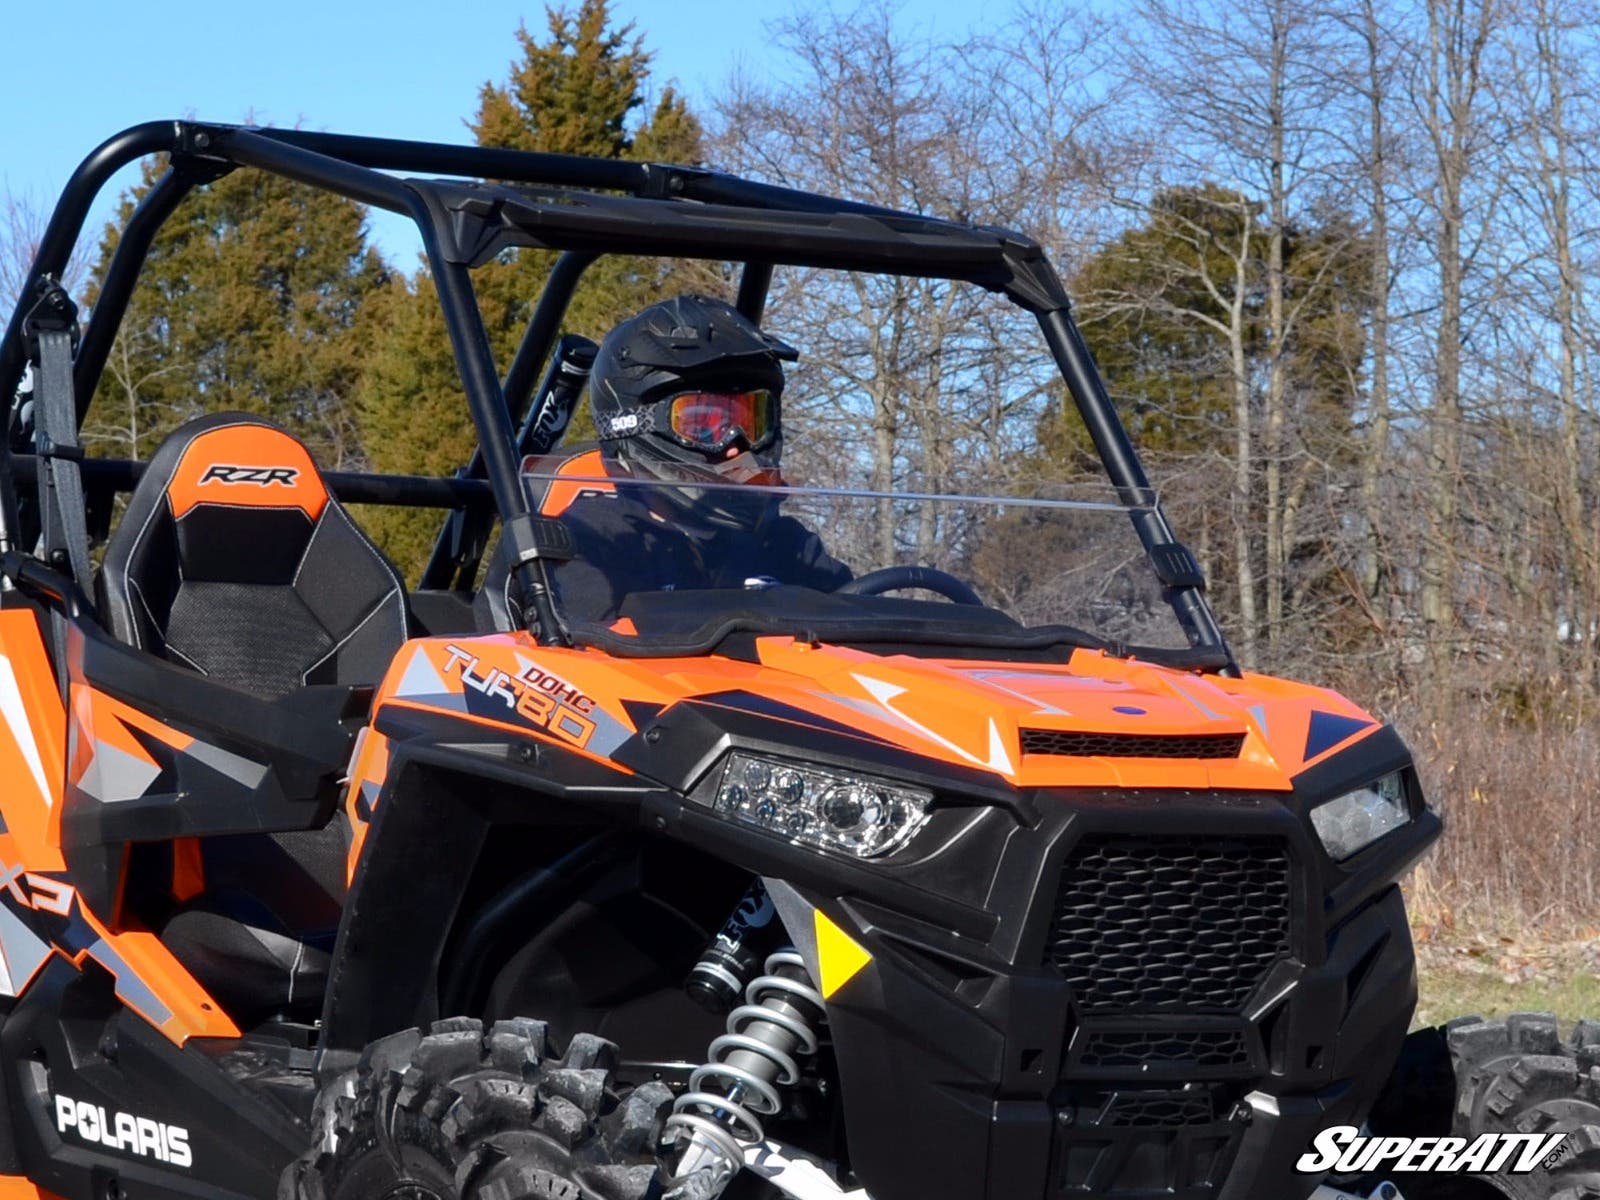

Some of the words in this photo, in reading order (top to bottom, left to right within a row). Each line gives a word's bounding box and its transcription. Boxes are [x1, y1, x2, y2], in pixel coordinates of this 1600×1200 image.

[611, 414, 638, 432] 509
[198, 464, 298, 487] RZR
[443, 643, 598, 749] TURBO
[522, 666, 597, 714] DOHC
[55, 1093, 192, 1168] POLARIS
